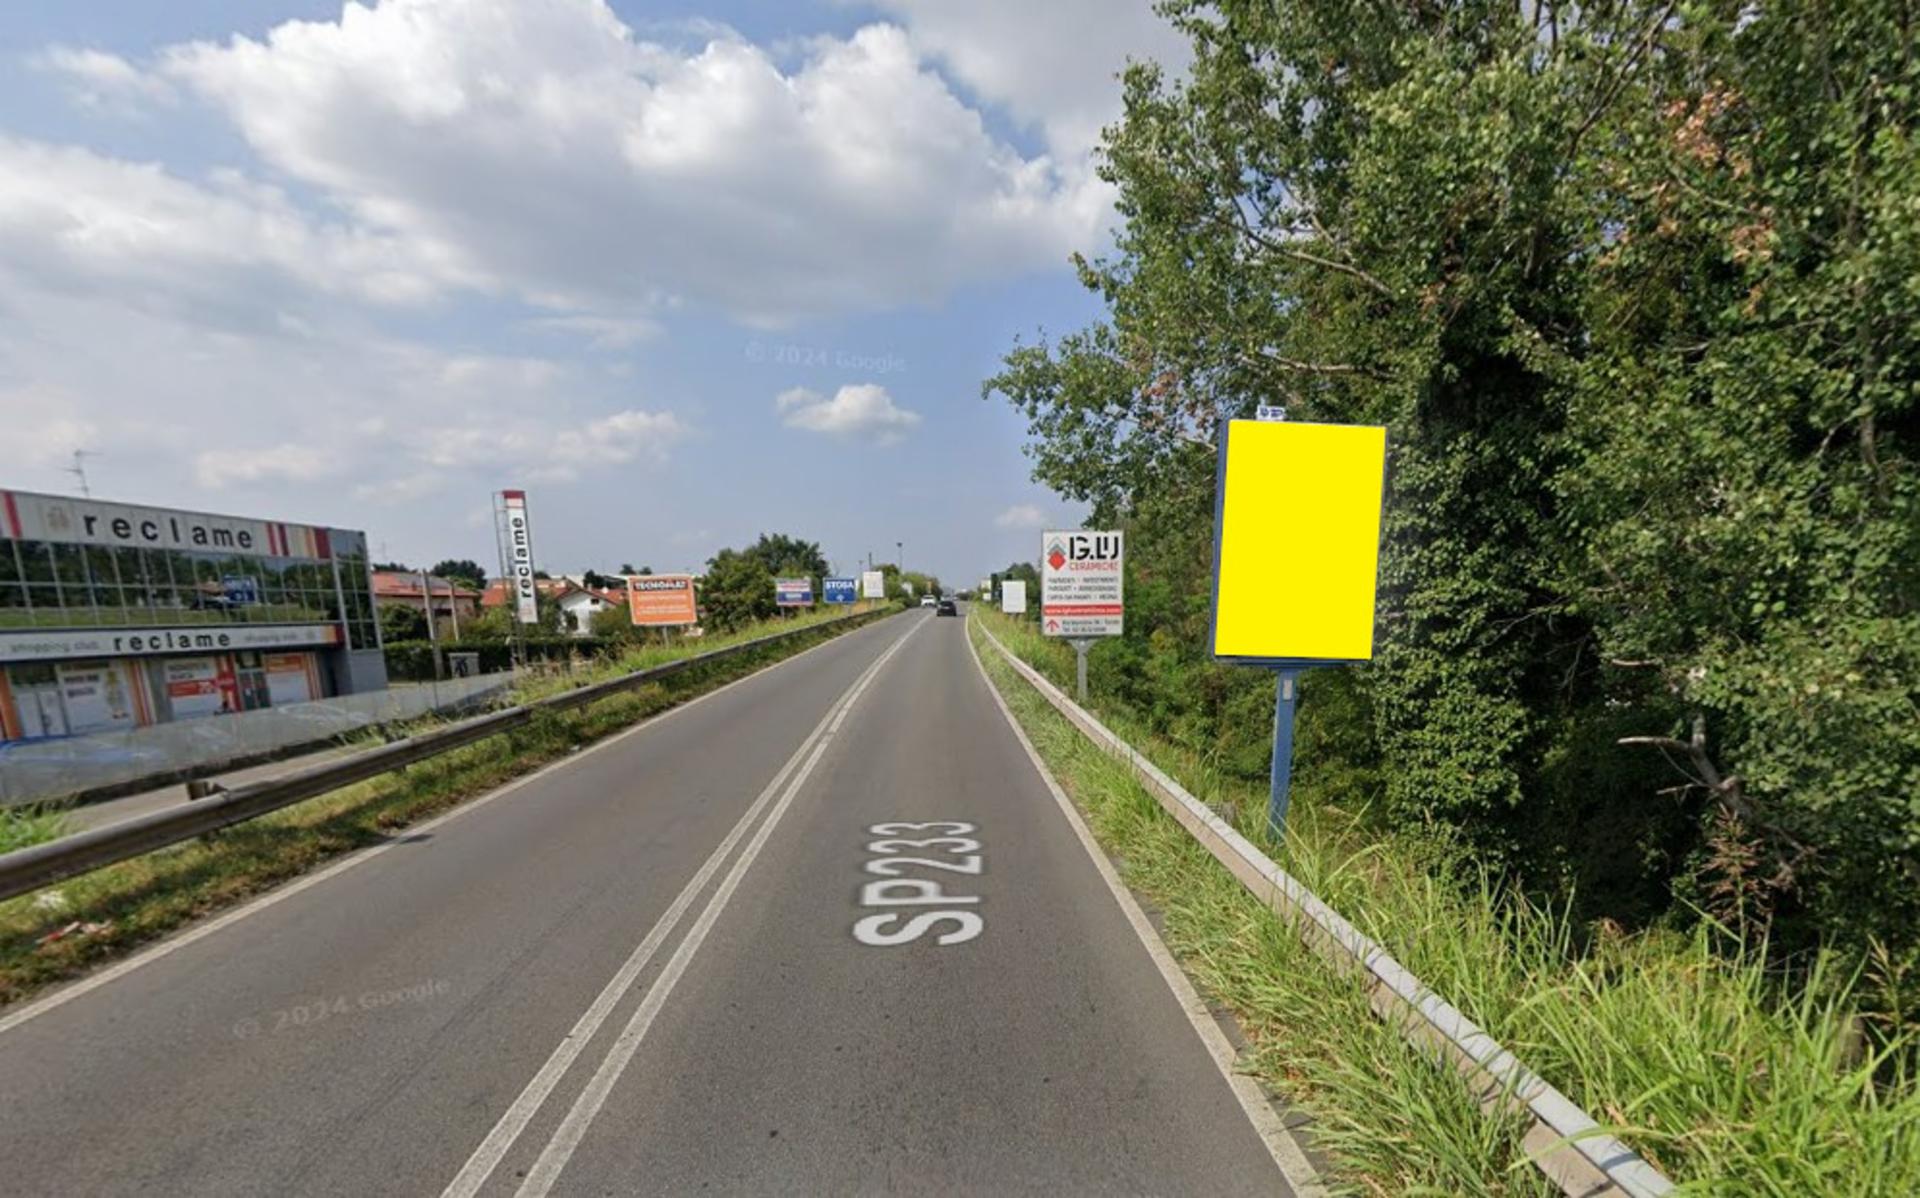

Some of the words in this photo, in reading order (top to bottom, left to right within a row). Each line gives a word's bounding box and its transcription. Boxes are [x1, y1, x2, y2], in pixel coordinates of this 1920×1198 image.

[84, 513, 252, 548] reclame
[512, 517, 531, 598] reclame
[114, 632, 231, 651] reclame
[853, 822, 983, 946] SP233
